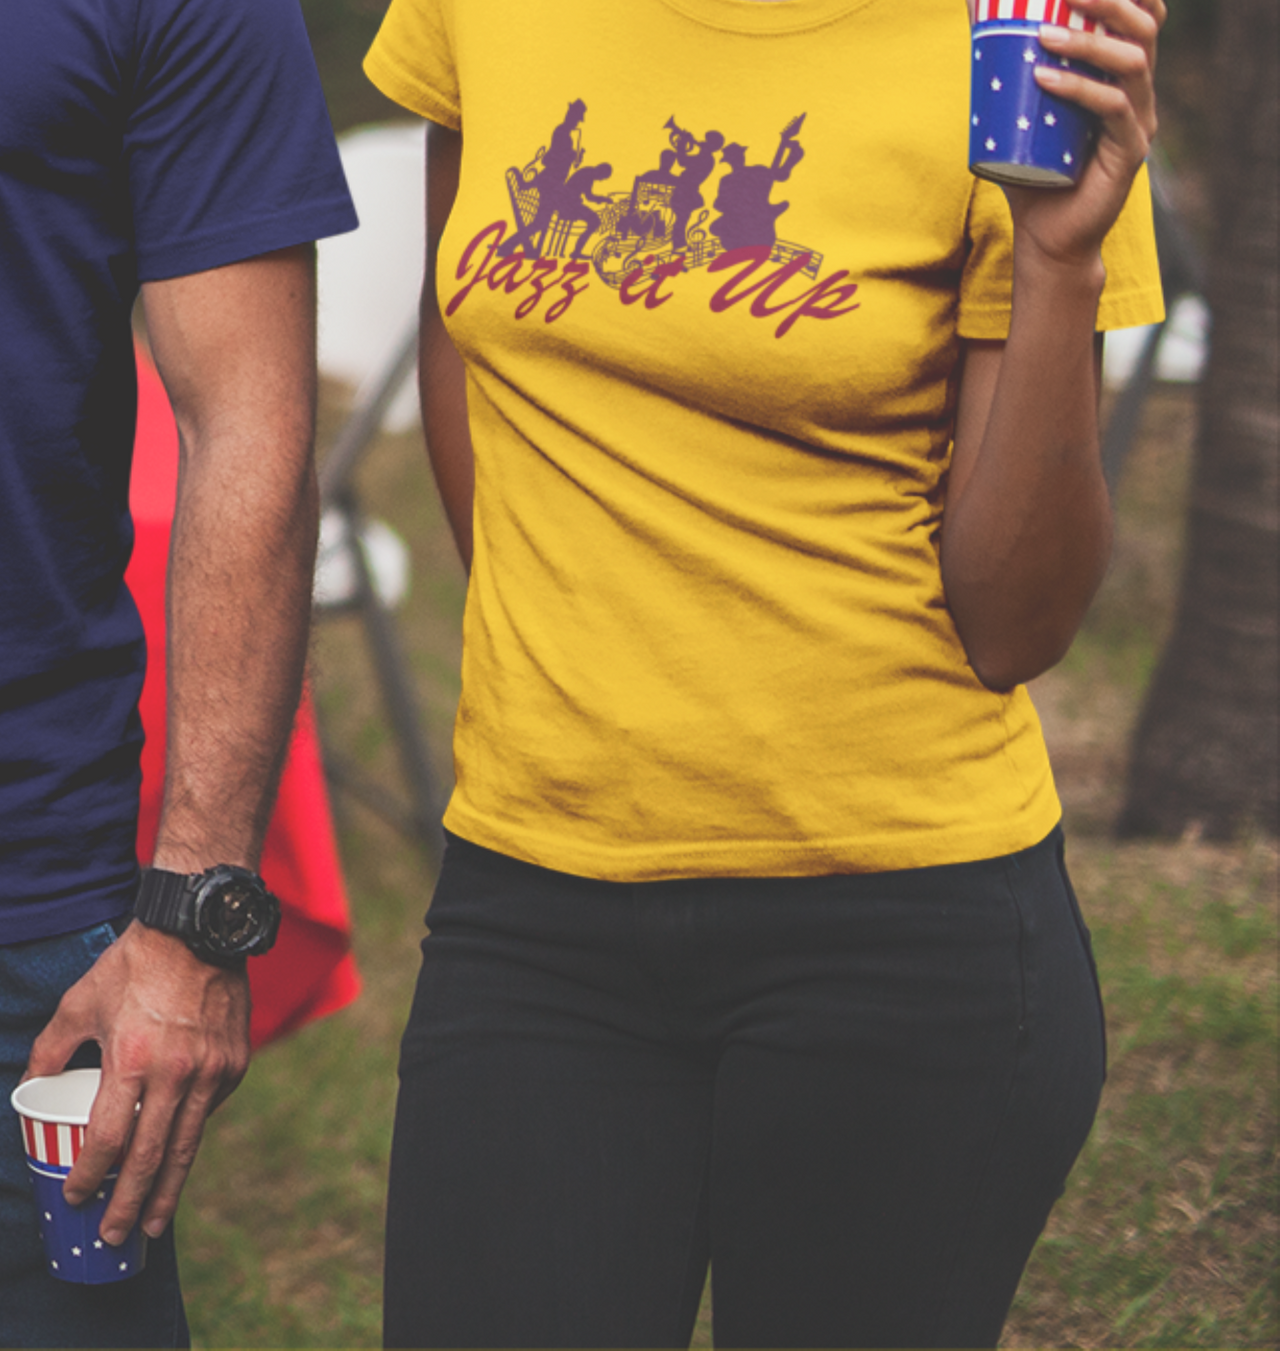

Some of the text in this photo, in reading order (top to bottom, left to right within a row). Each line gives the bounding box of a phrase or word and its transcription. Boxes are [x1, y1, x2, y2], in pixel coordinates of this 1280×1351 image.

[445, 220, 861, 339] Jazz it Up
